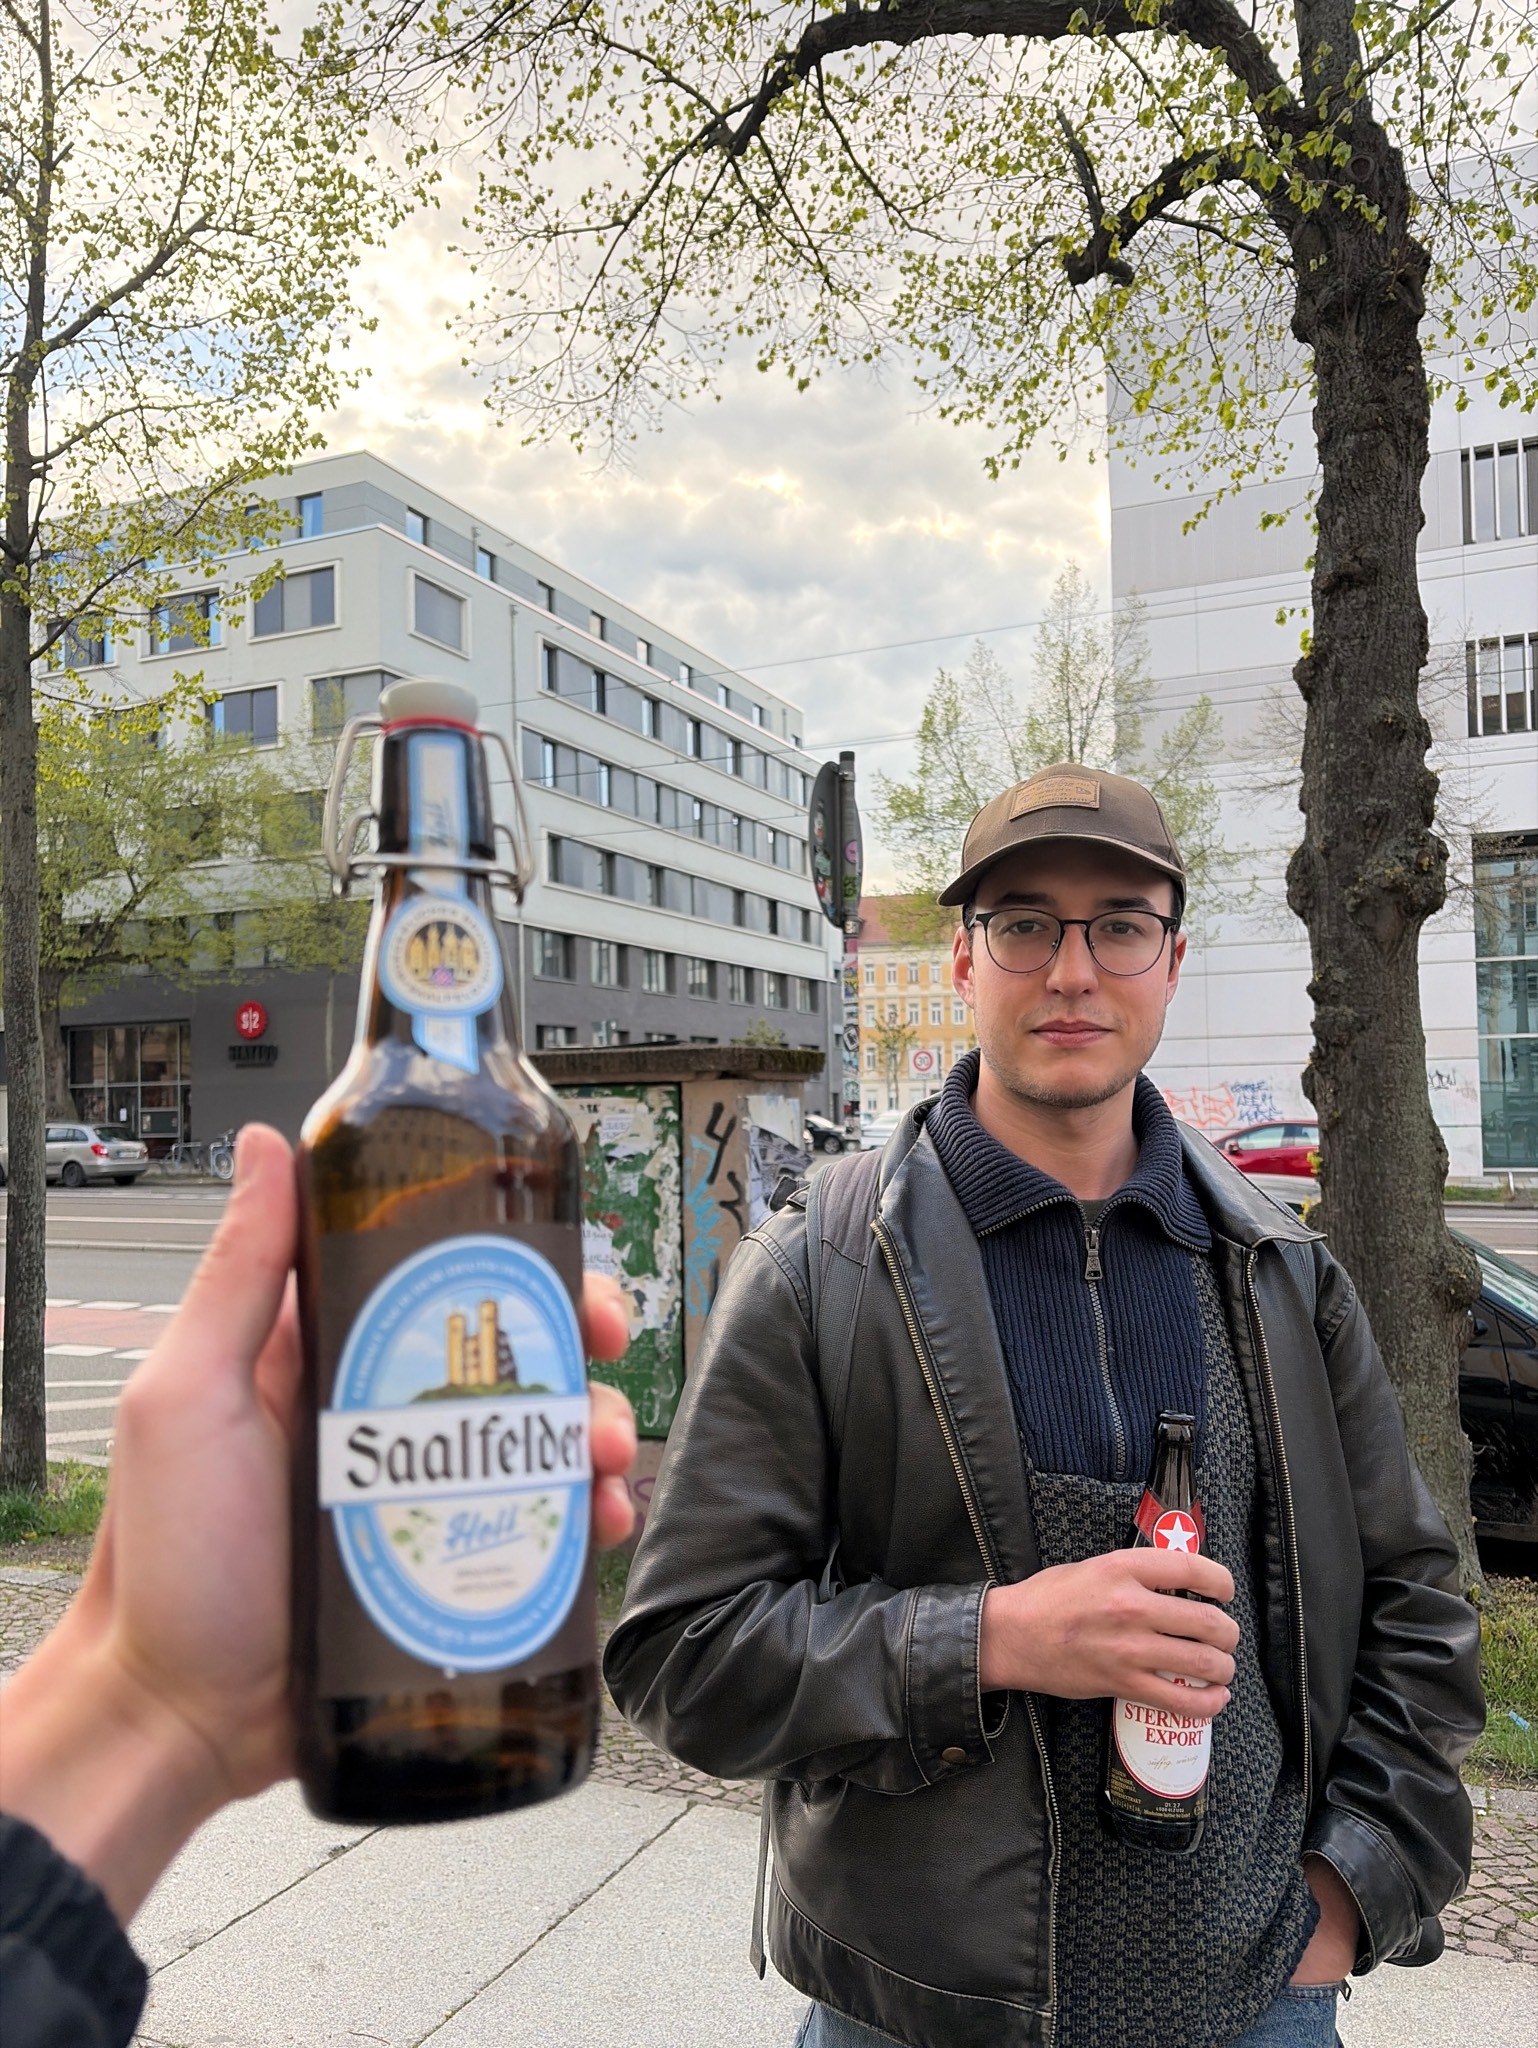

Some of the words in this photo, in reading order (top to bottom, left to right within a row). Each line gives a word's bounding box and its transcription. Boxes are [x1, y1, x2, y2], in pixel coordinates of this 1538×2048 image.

[346, 1413, 583, 1489] Saalfelder
[445, 1504, 518, 1551] Hell
[1145, 1727, 1204, 1747] EXPORT
